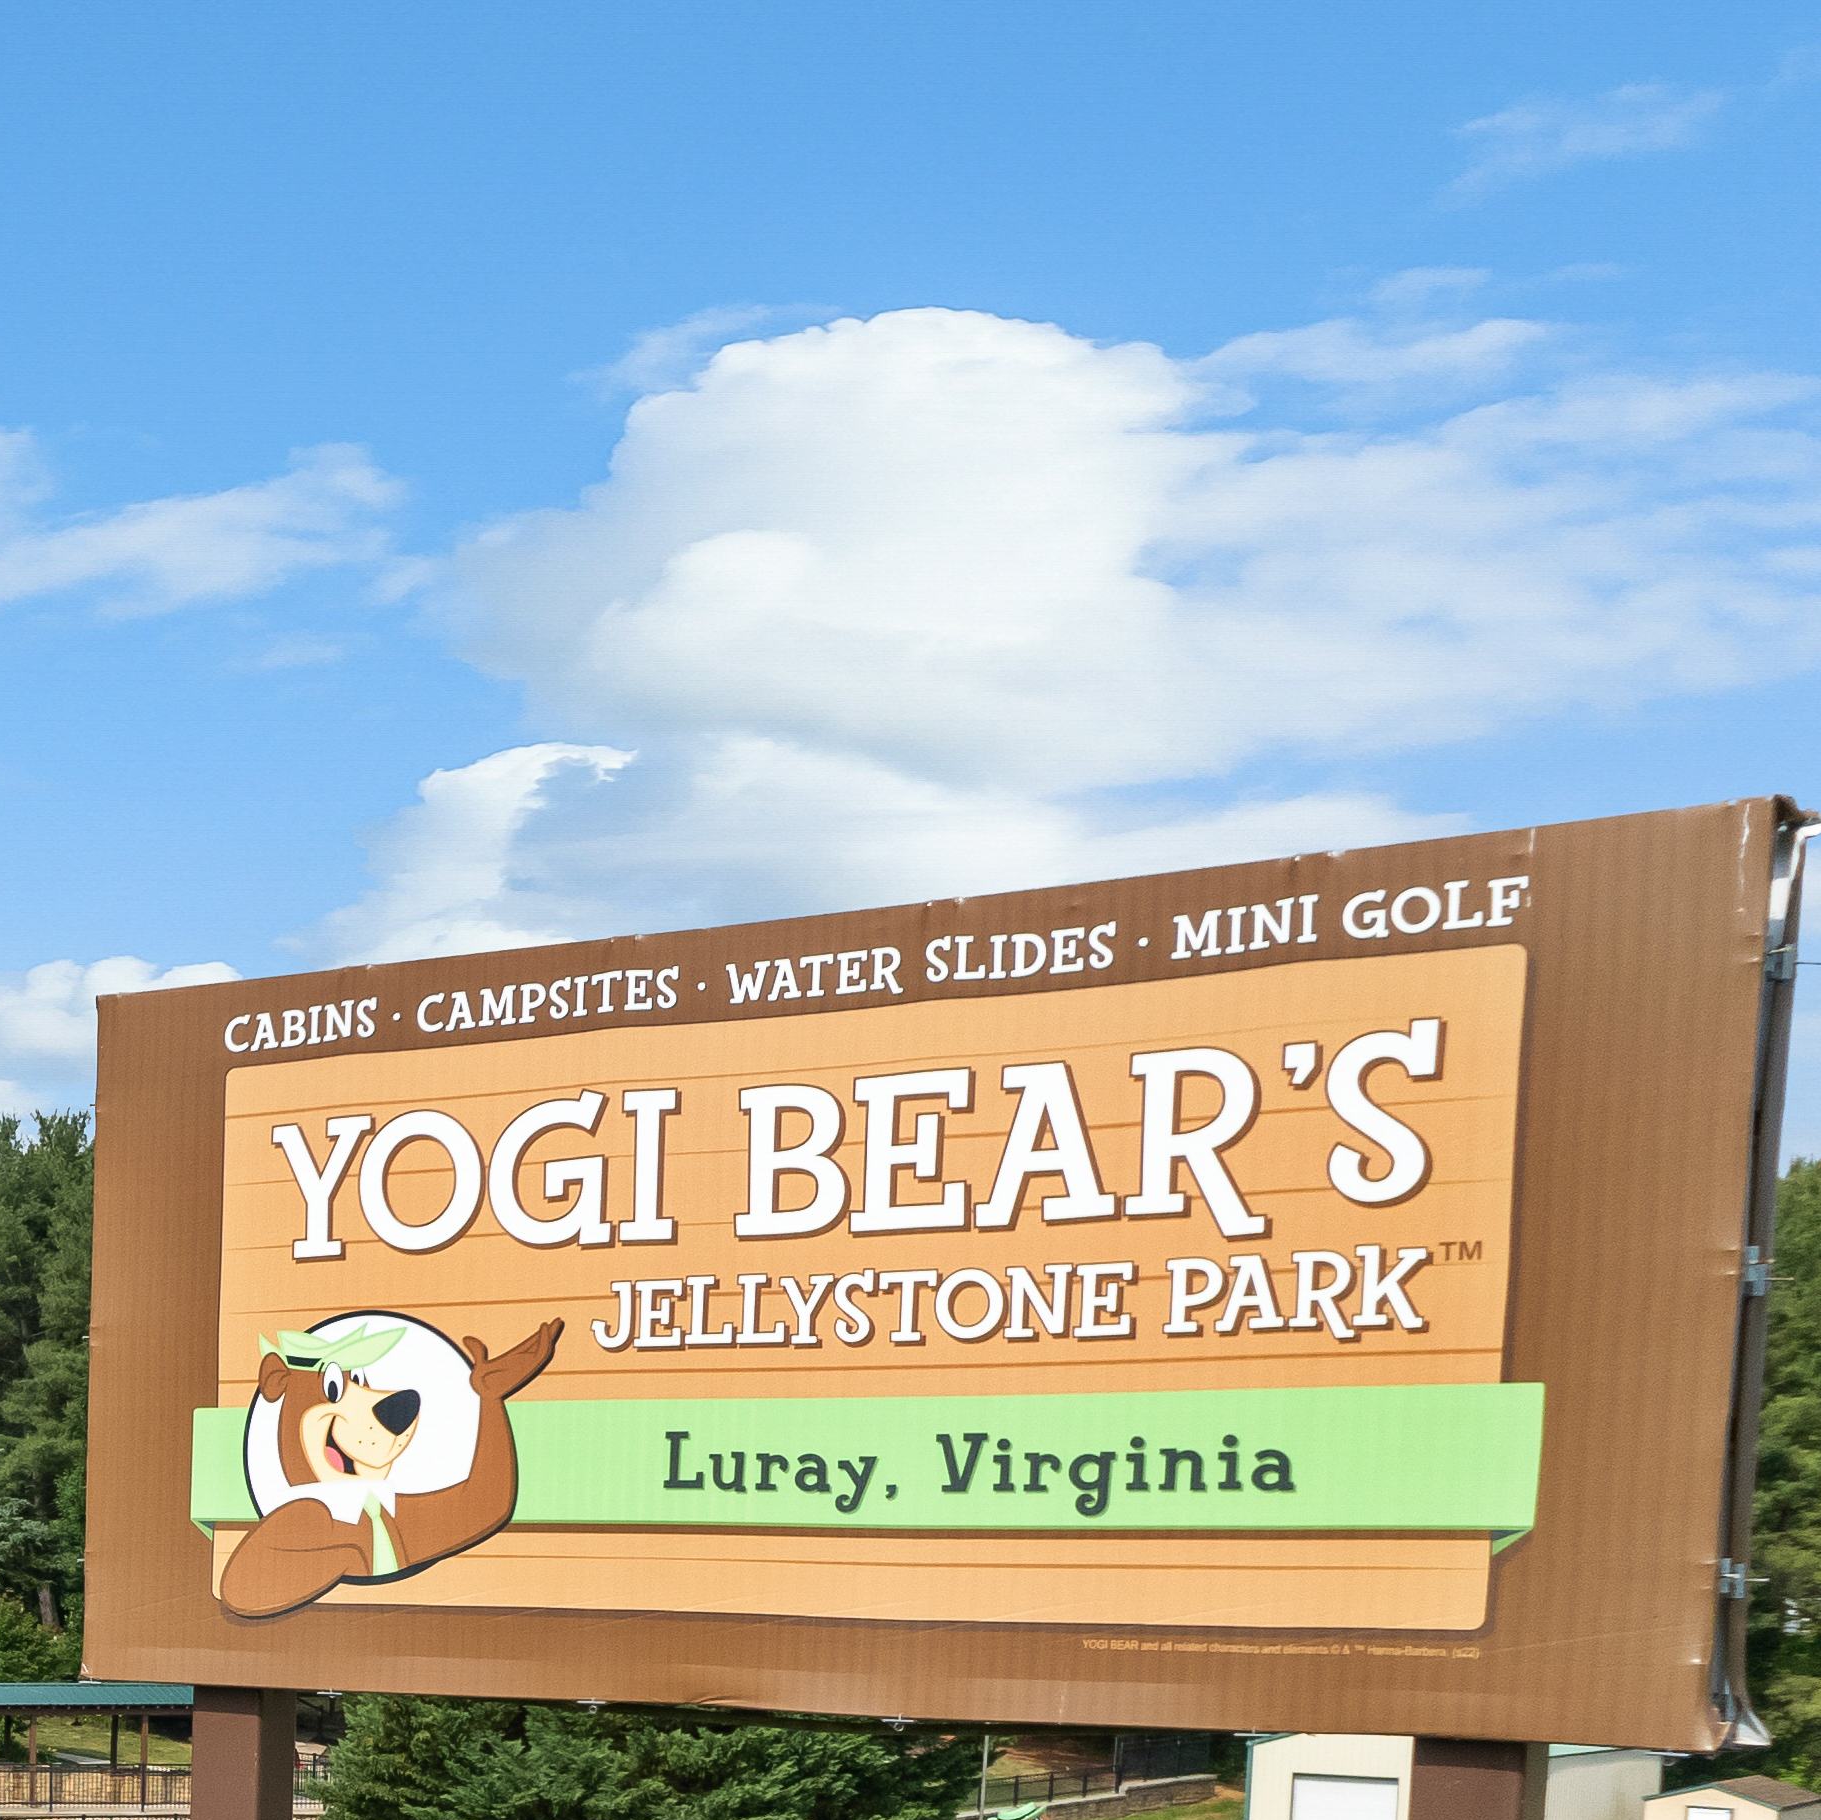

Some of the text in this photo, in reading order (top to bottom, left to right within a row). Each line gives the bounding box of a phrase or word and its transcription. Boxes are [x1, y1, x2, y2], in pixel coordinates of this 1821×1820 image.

[223, 875, 1531, 1054] CABINS CAMPSITES WATER SLIDES MINI GOLF
[271, 1018, 1442, 1262] YOGI BEAR'S
[590, 1262, 1134, 1352] JELLYSTONE
[662, 1430, 1296, 1518] Luray, Virginia
[1110, 1639, 1139, 1651] BEAR
